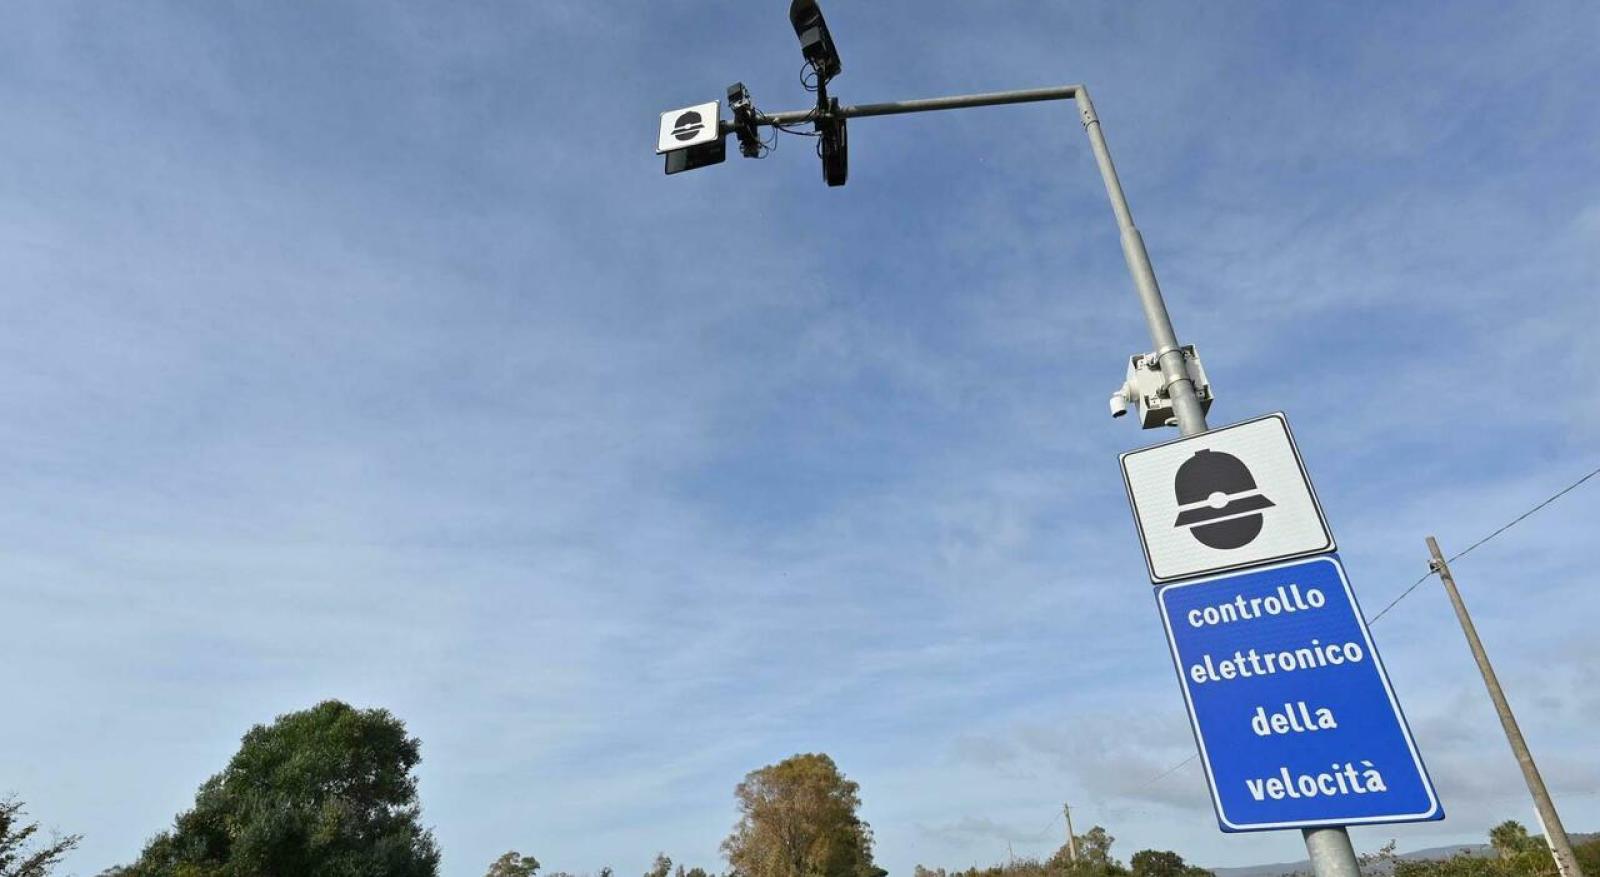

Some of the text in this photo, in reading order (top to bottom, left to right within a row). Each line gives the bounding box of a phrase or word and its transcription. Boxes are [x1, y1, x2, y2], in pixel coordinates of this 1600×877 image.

[1188, 583, 1326, 628] controllo
[1190, 639, 1363, 684] elettronico
[1251, 701, 1338, 736] della
[1245, 760, 1387, 801] velocità
